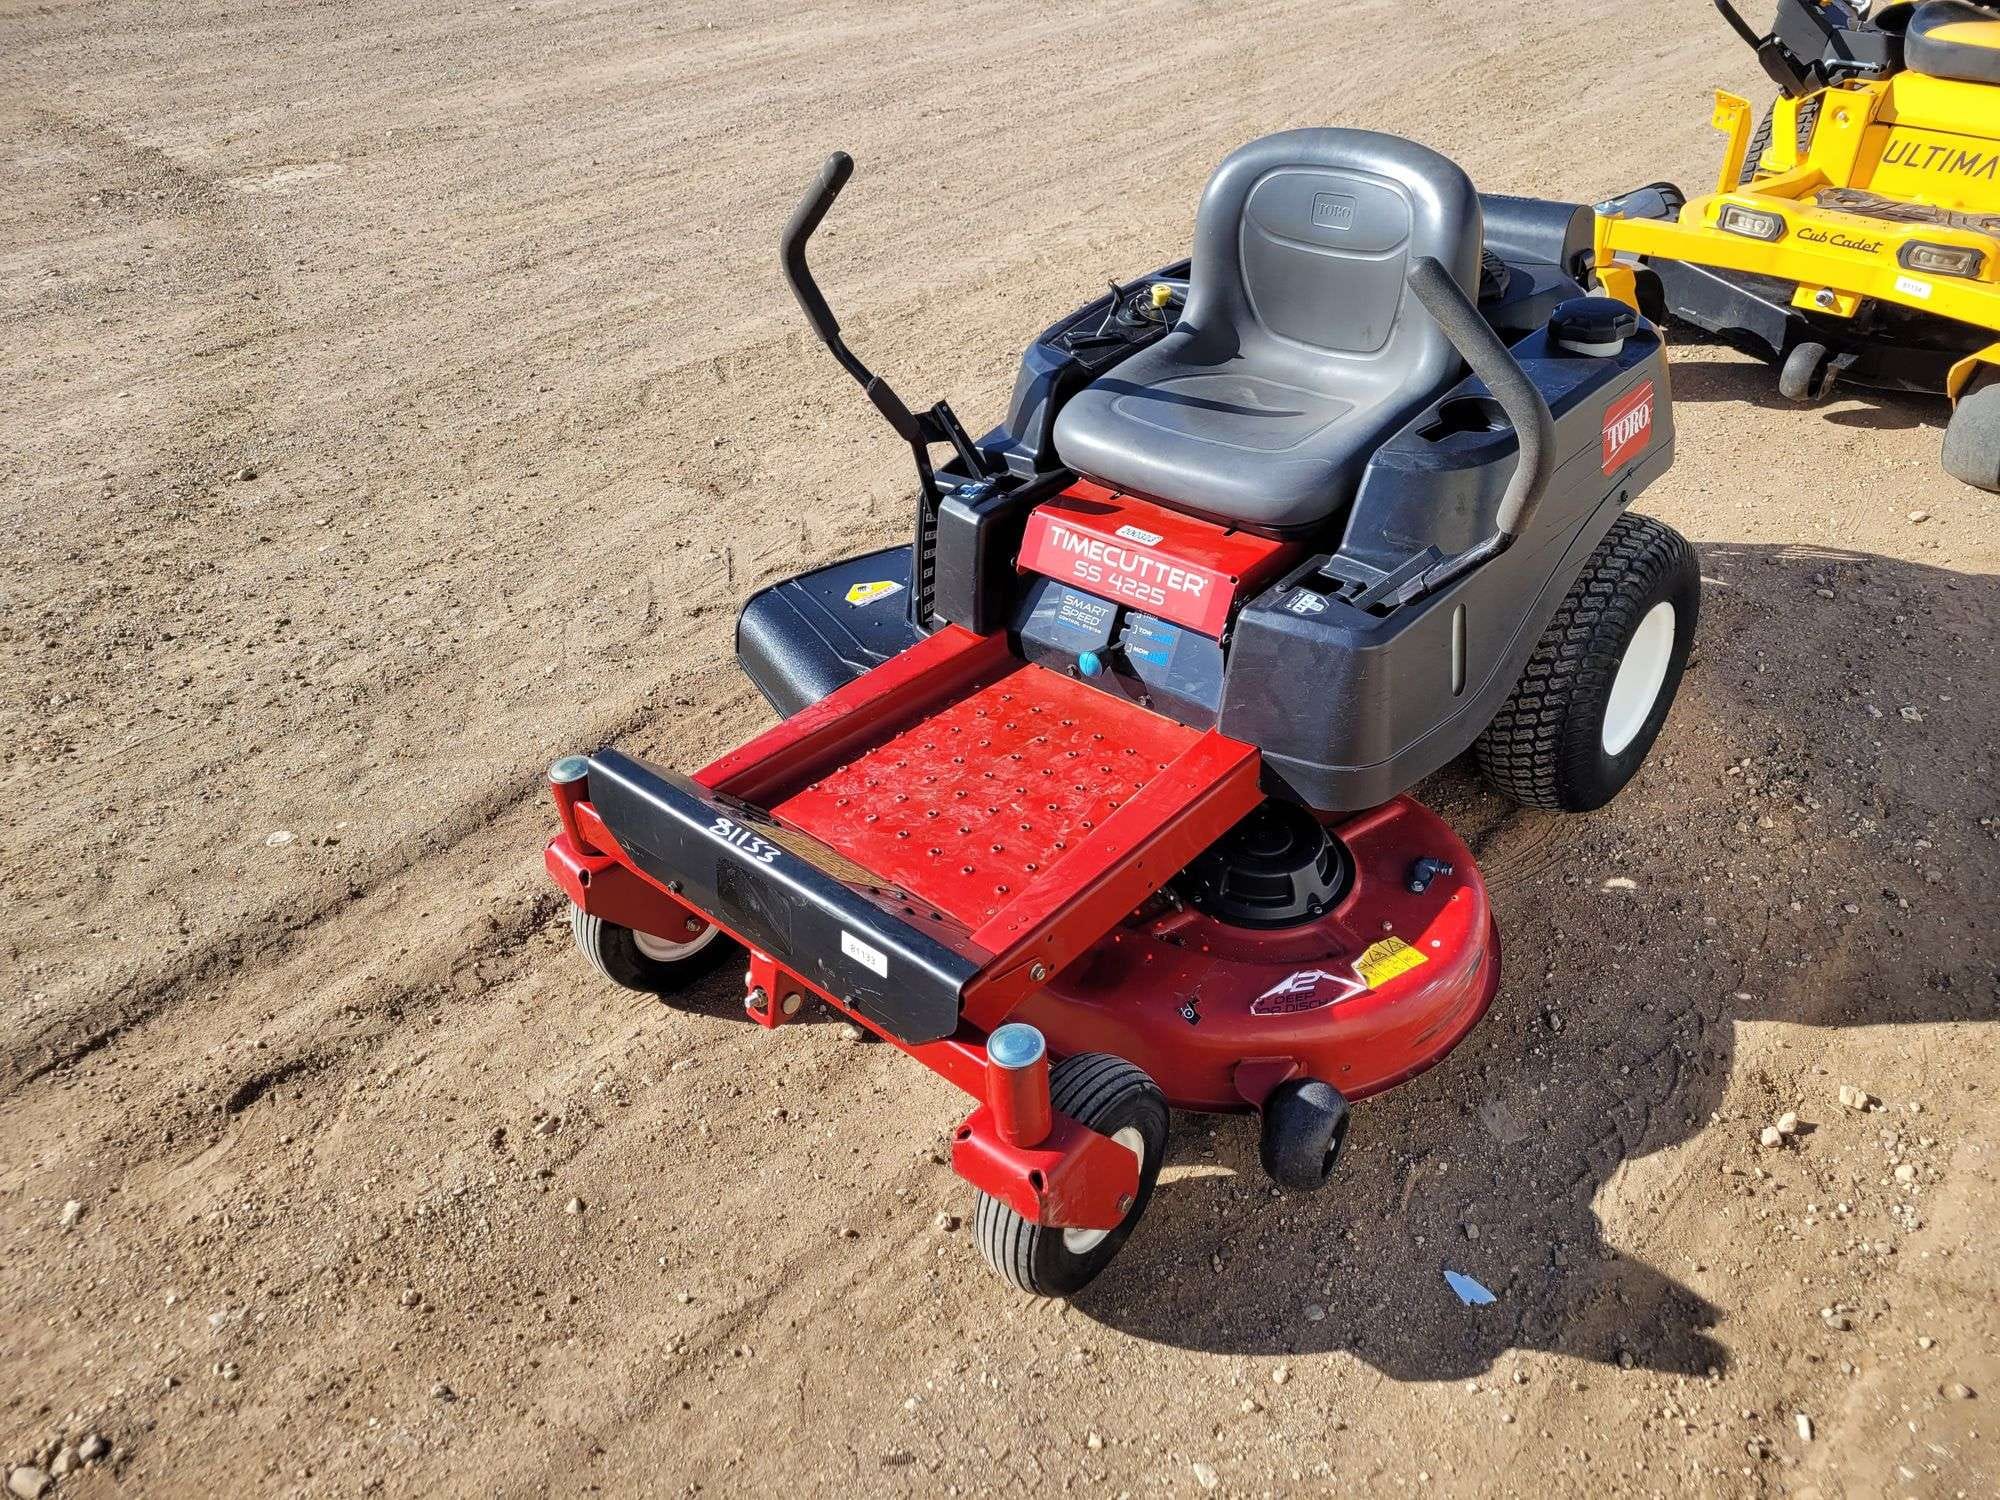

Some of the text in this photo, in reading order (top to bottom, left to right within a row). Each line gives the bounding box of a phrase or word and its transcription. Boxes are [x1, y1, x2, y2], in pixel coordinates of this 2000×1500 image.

[1882, 140, 2000, 180] ULTIMA
[1797, 227, 1885, 254] Cub Cadet
[1607, 403, 1650, 453] TORO
[1051, 526, 1207, 597] TIMECUTTER
[1072, 561, 1167, 606] SS 4225
[1059, 605, 1102, 627] SPEED
[1063, 594, 1109, 617] SMART
[1133, 645, 1150, 656] MOW
[708, 817, 782, 864] 81133
